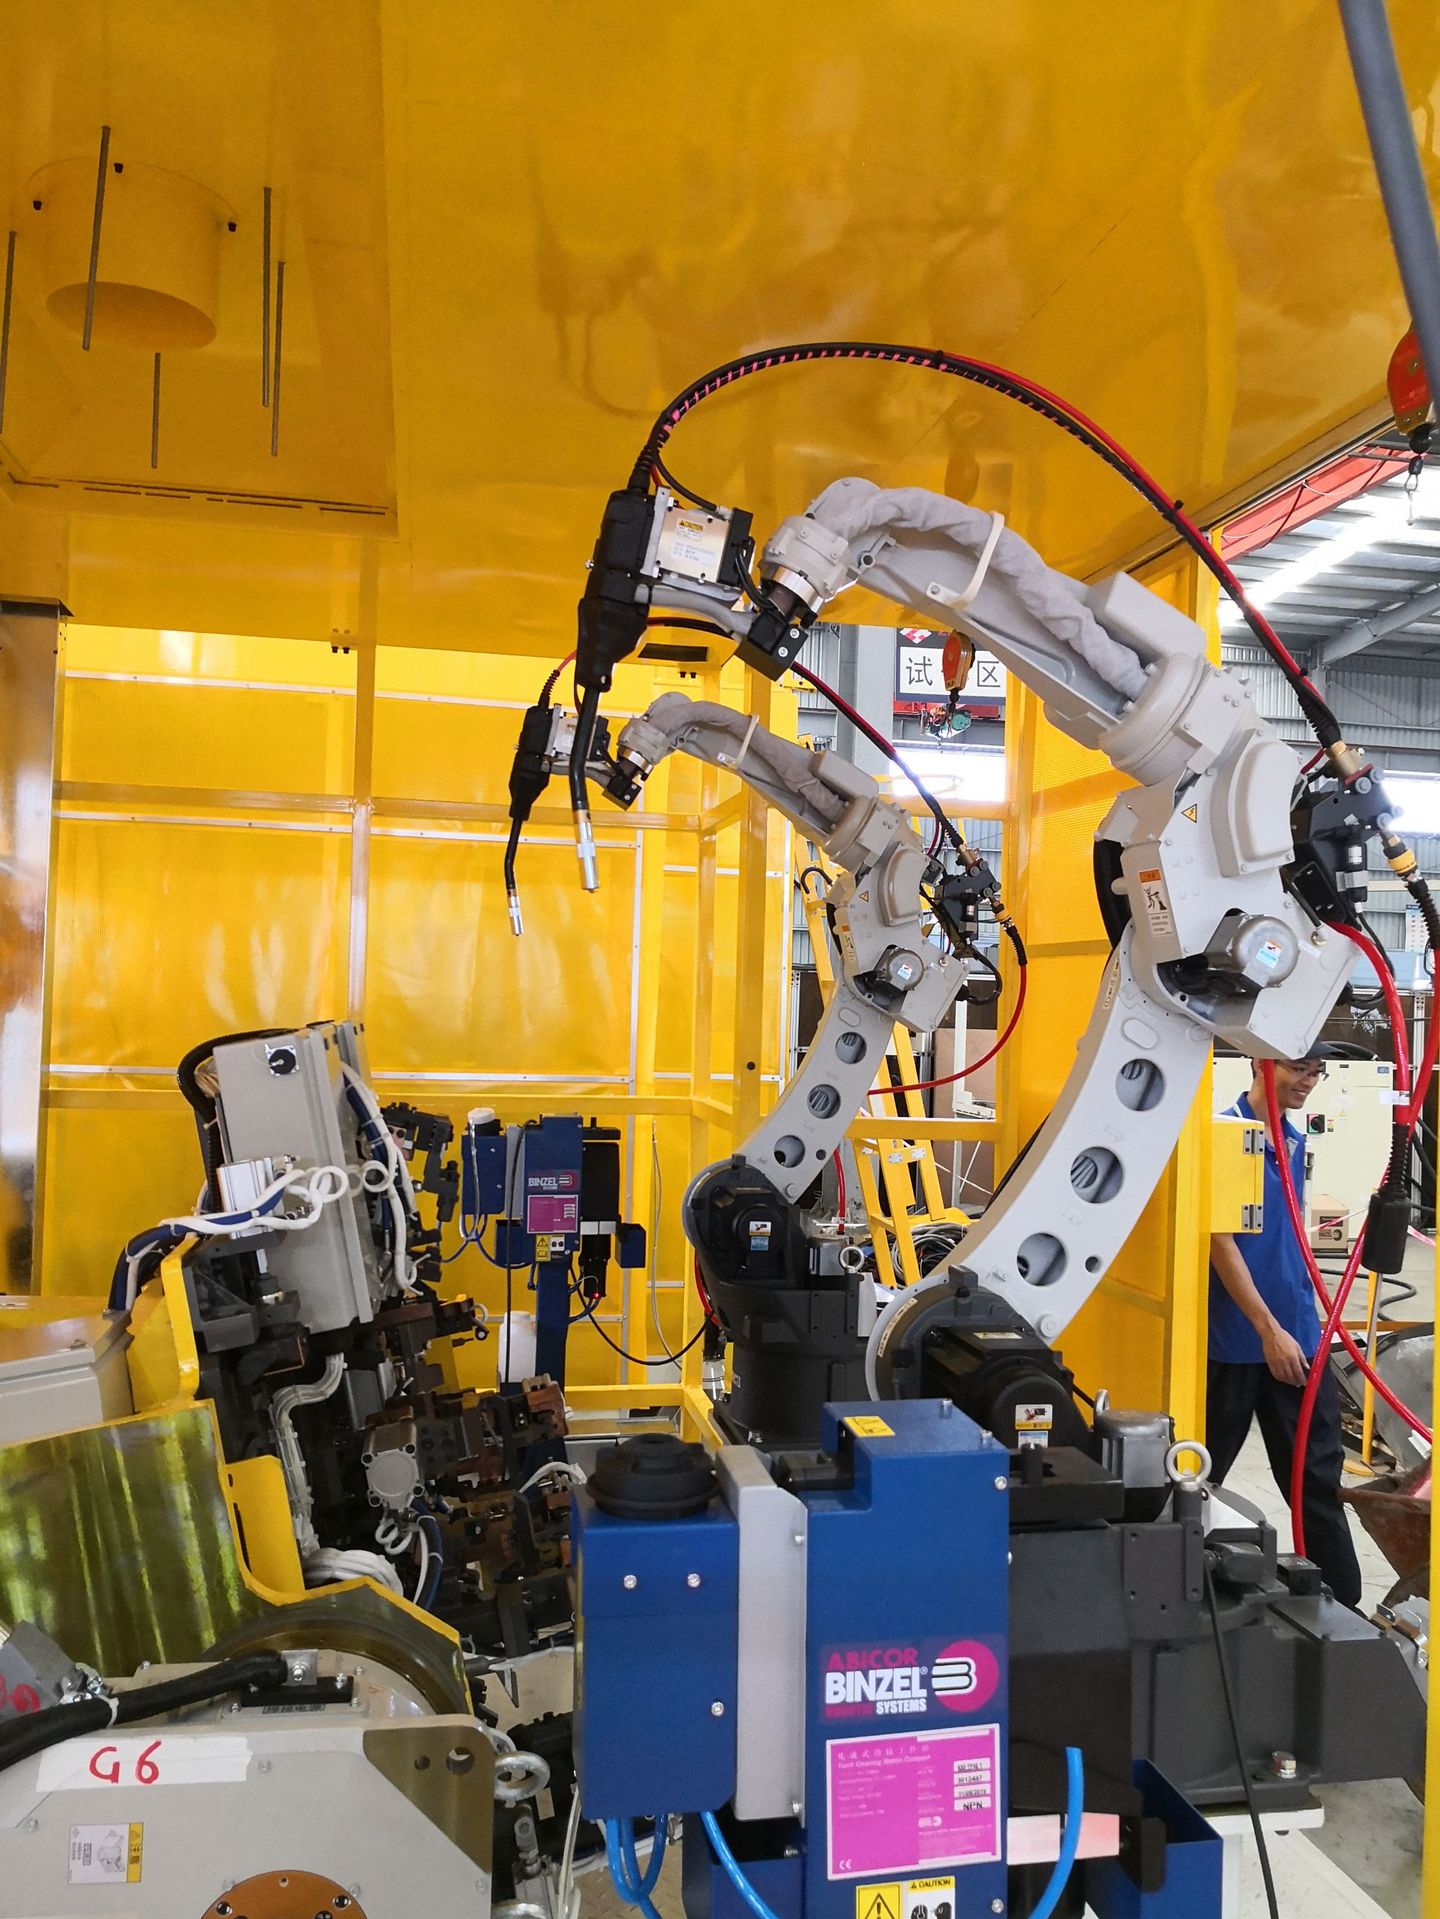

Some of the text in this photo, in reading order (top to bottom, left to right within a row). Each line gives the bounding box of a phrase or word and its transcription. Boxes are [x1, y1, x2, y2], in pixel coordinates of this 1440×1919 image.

[905, 655, 1001, 688] 试区
[528, 1176, 559, 1187] BINZEL
[826, 1647, 919, 1670] ABICOR
[875, 1698, 928, 1716] SYSTEMS
[962, 1801, 984, 1811] NPN
[918, 1878, 952, 1889] CAUTION
